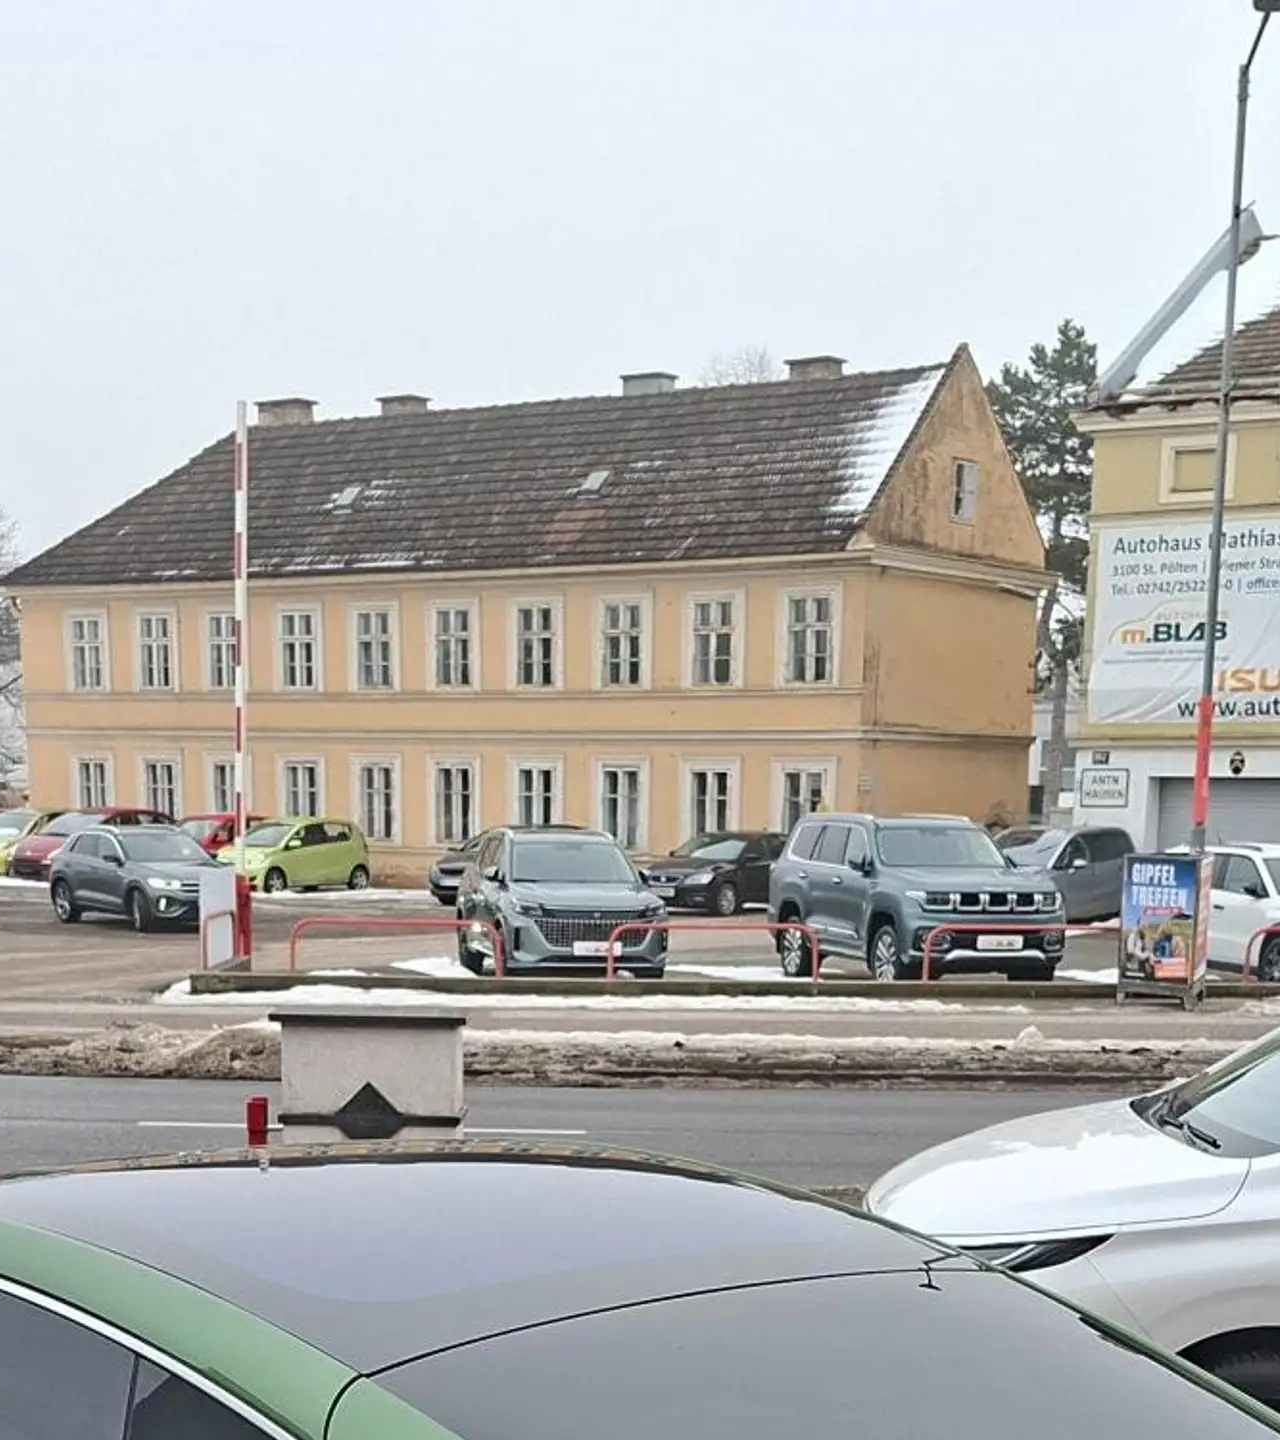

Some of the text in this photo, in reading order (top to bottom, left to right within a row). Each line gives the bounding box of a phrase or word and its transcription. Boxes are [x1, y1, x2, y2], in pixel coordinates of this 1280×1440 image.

[1112, 533, 1202, 555] Autohaus
[1111, 563, 1140, 577] 3100
[1219, 557, 1255, 572] iener
[1122, 621, 1227, 644] m.BLAB
[1132, 862, 1177, 887] GIPFEL
